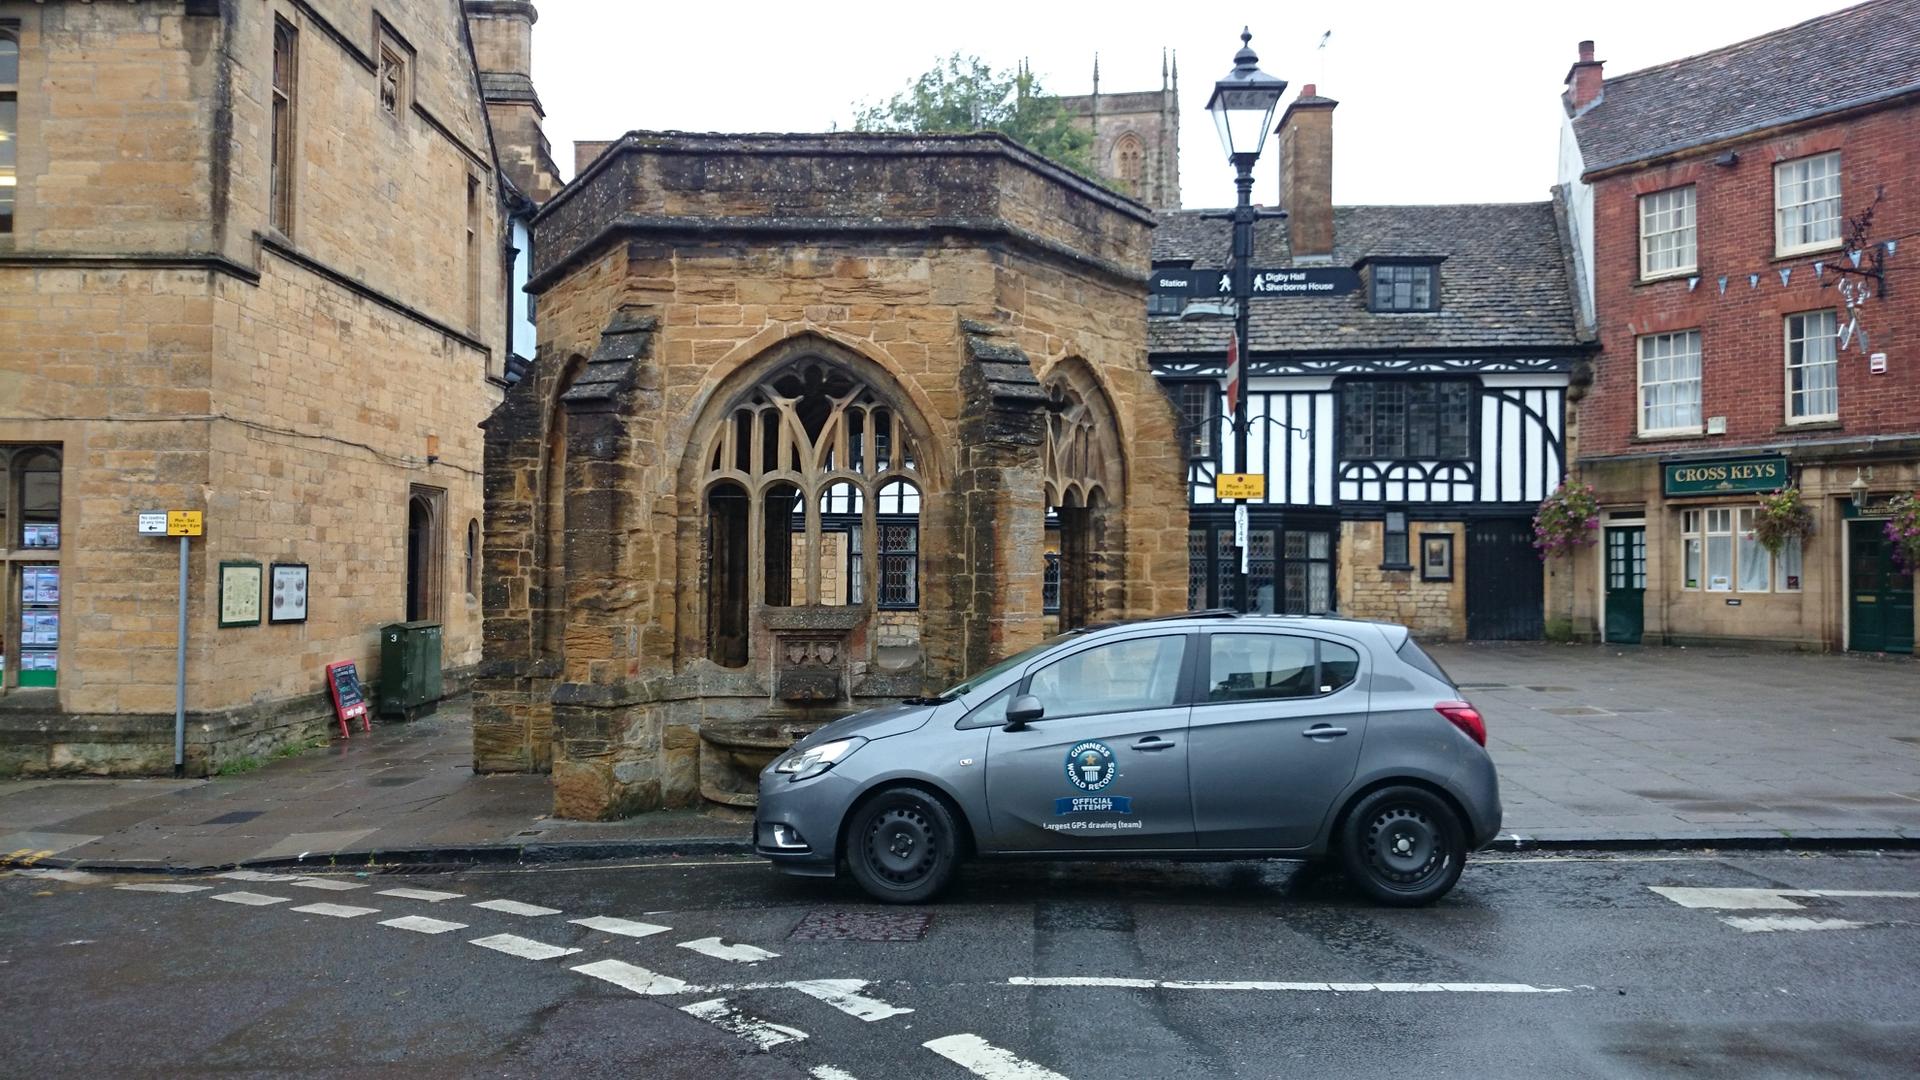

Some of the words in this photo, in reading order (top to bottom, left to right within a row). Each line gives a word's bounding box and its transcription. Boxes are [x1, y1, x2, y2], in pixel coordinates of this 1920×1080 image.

[1160, 278, 1188, 288] Station
[1265, 272, 1289, 283] Digby
[1290, 272, 1306, 281] Hall
[1265, 282, 1307, 292] Sherborne
[1308, 281, 1334, 291] House
[1675, 466, 1727, 482] CROSS
[1731, 463, 1776, 479] KEYS
[390, 634, 398, 643] 3
[1071, 742, 1111, 758] GUINNESS
[1067, 763, 1086, 789] WORLD
[1088, 762, 1115, 791] RECORDS
[1043, 821, 1071, 831] Largest
[1071, 821, 1087, 829] GPS
[1088, 821, 1117, 830] drawing
[1118, 820, 1142, 829] (team)
